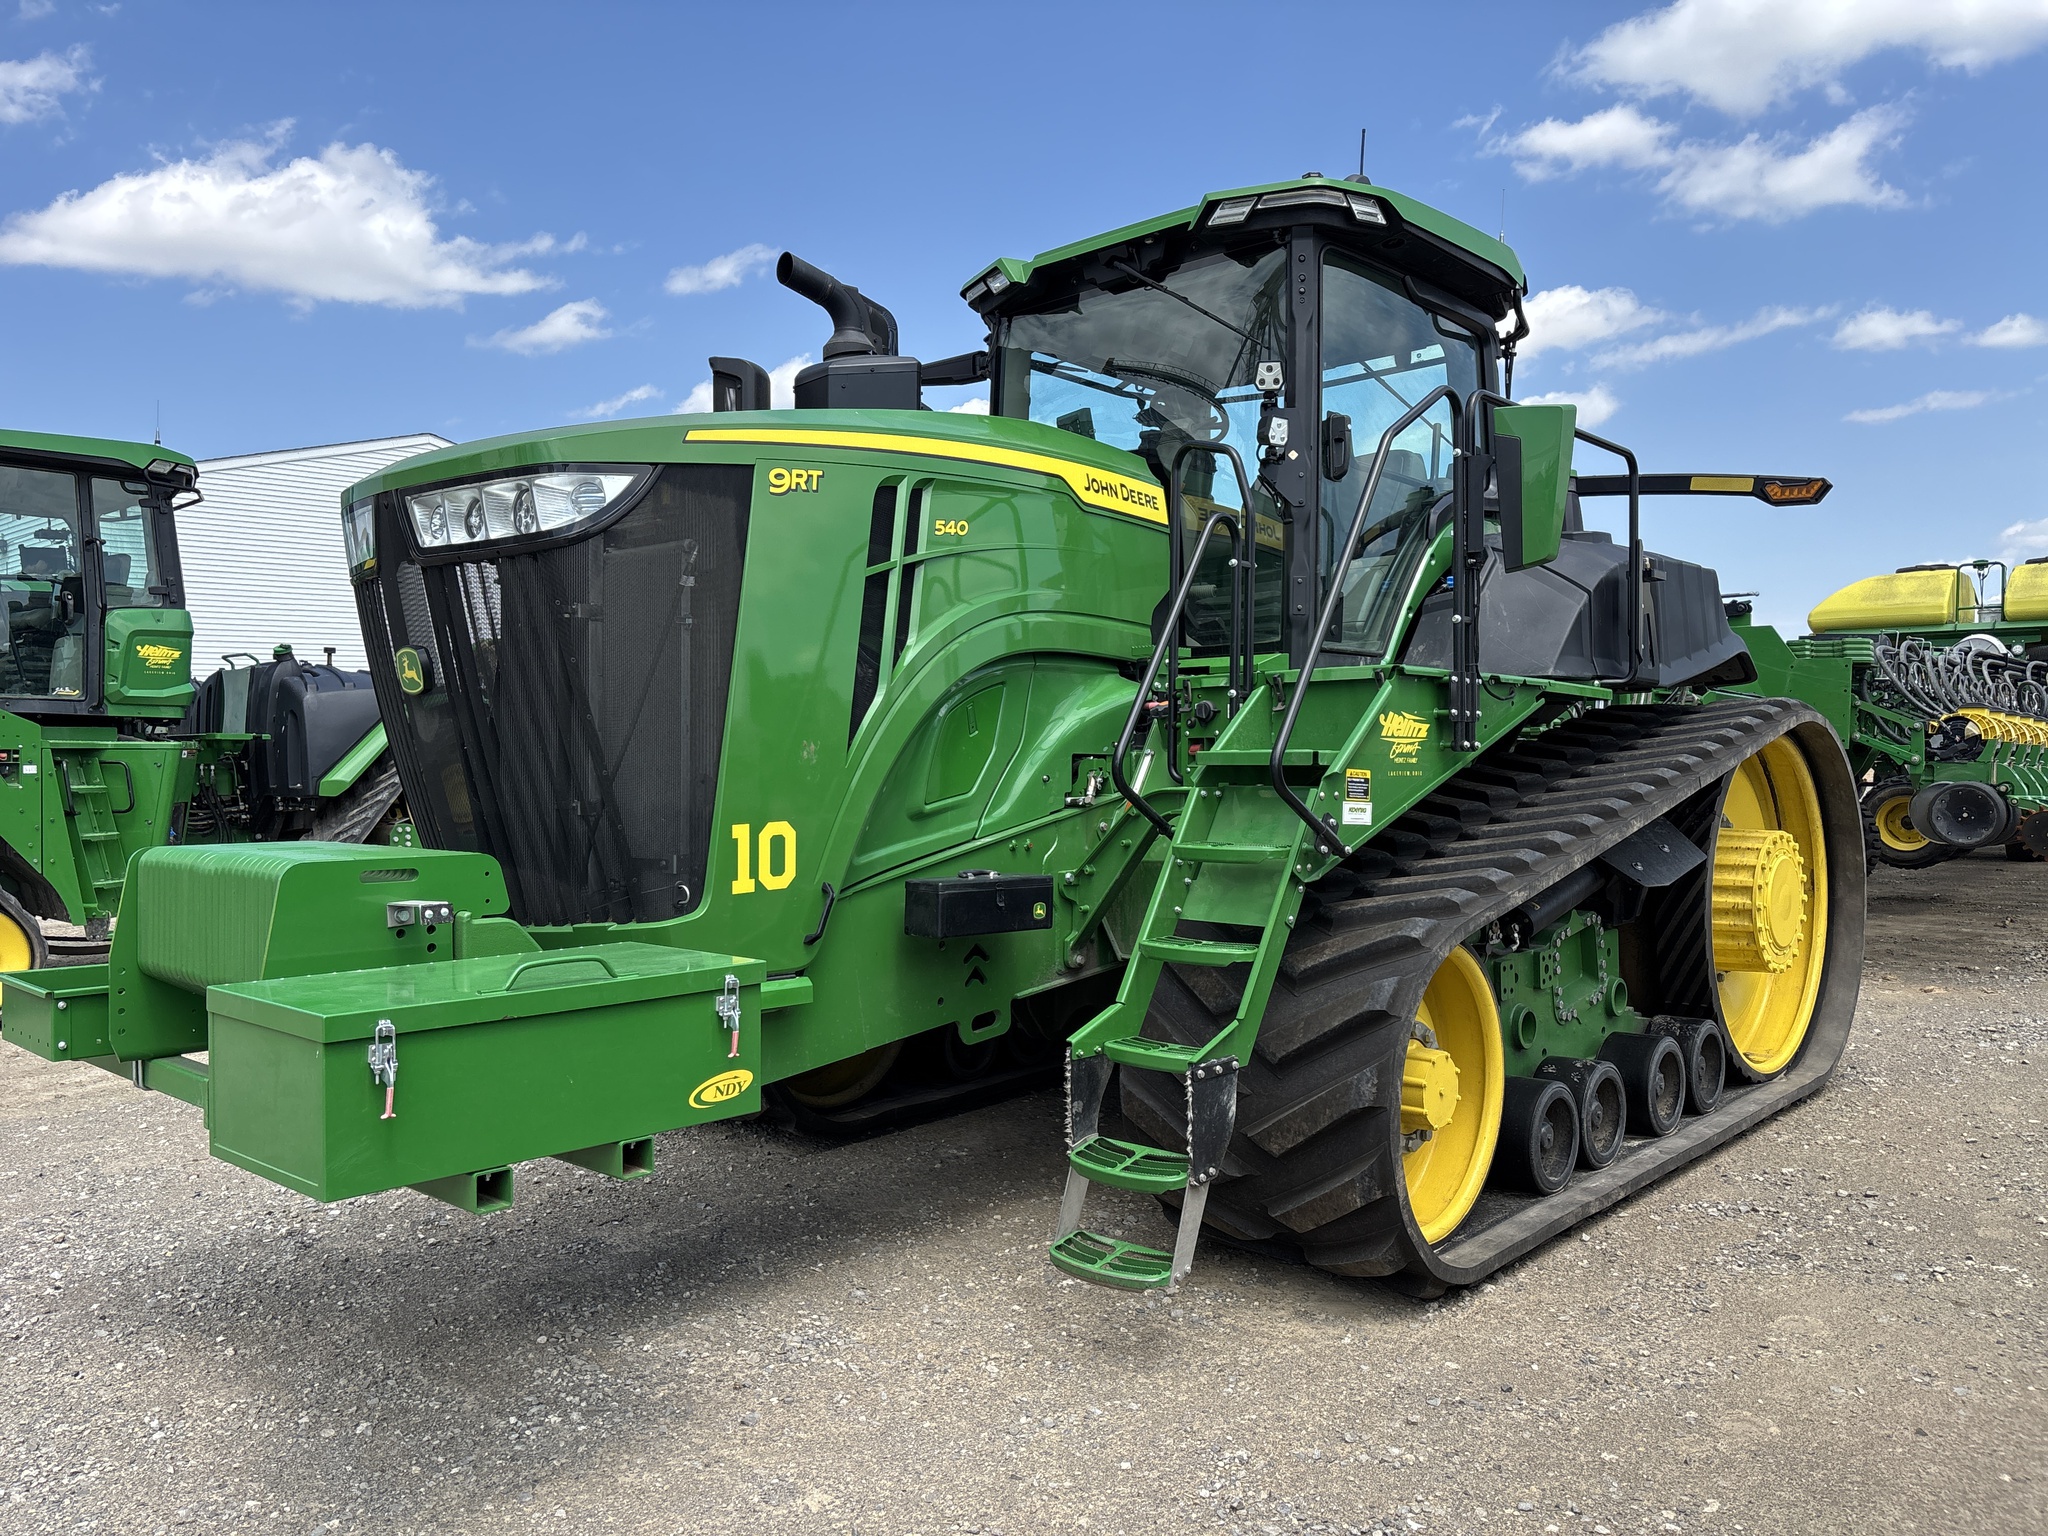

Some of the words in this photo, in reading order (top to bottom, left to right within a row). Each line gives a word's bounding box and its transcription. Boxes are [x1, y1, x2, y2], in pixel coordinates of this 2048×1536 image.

[768, 467, 824, 495] 9RT
[1084, 472, 1119, 500] JOHN
[1119, 482, 1160, 511] DEERE
[934, 519, 969, 536] 540
[731, 820, 797, 895] 10
[713, 1080, 747, 1099] NDY
